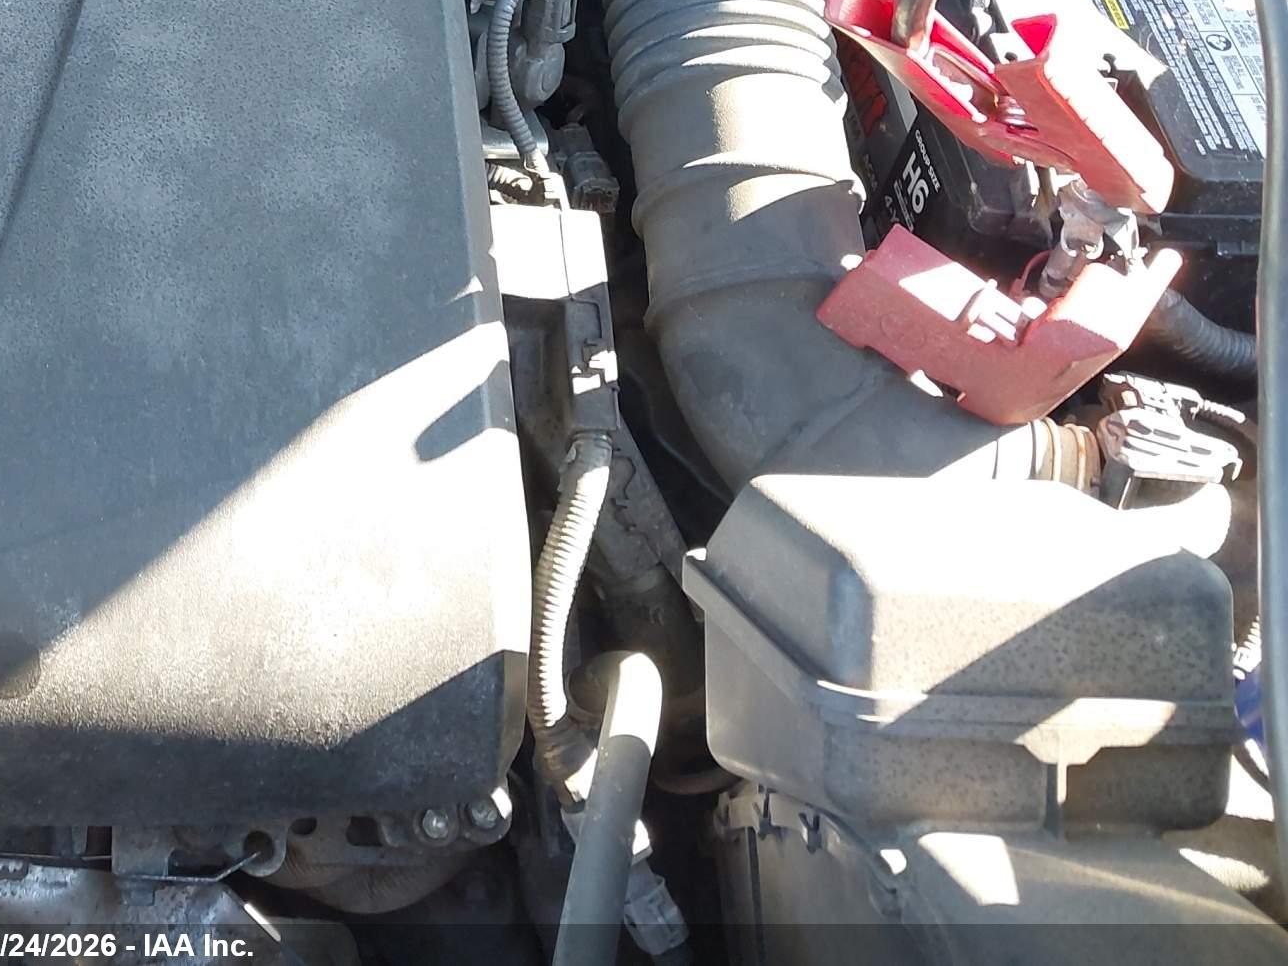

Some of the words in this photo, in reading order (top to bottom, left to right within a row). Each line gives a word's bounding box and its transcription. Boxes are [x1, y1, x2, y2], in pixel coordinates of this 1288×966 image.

[902, 151, 930, 214] H6
[915, 129, 931, 167] GROUP
[928, 166, 941, 193] SIZE
